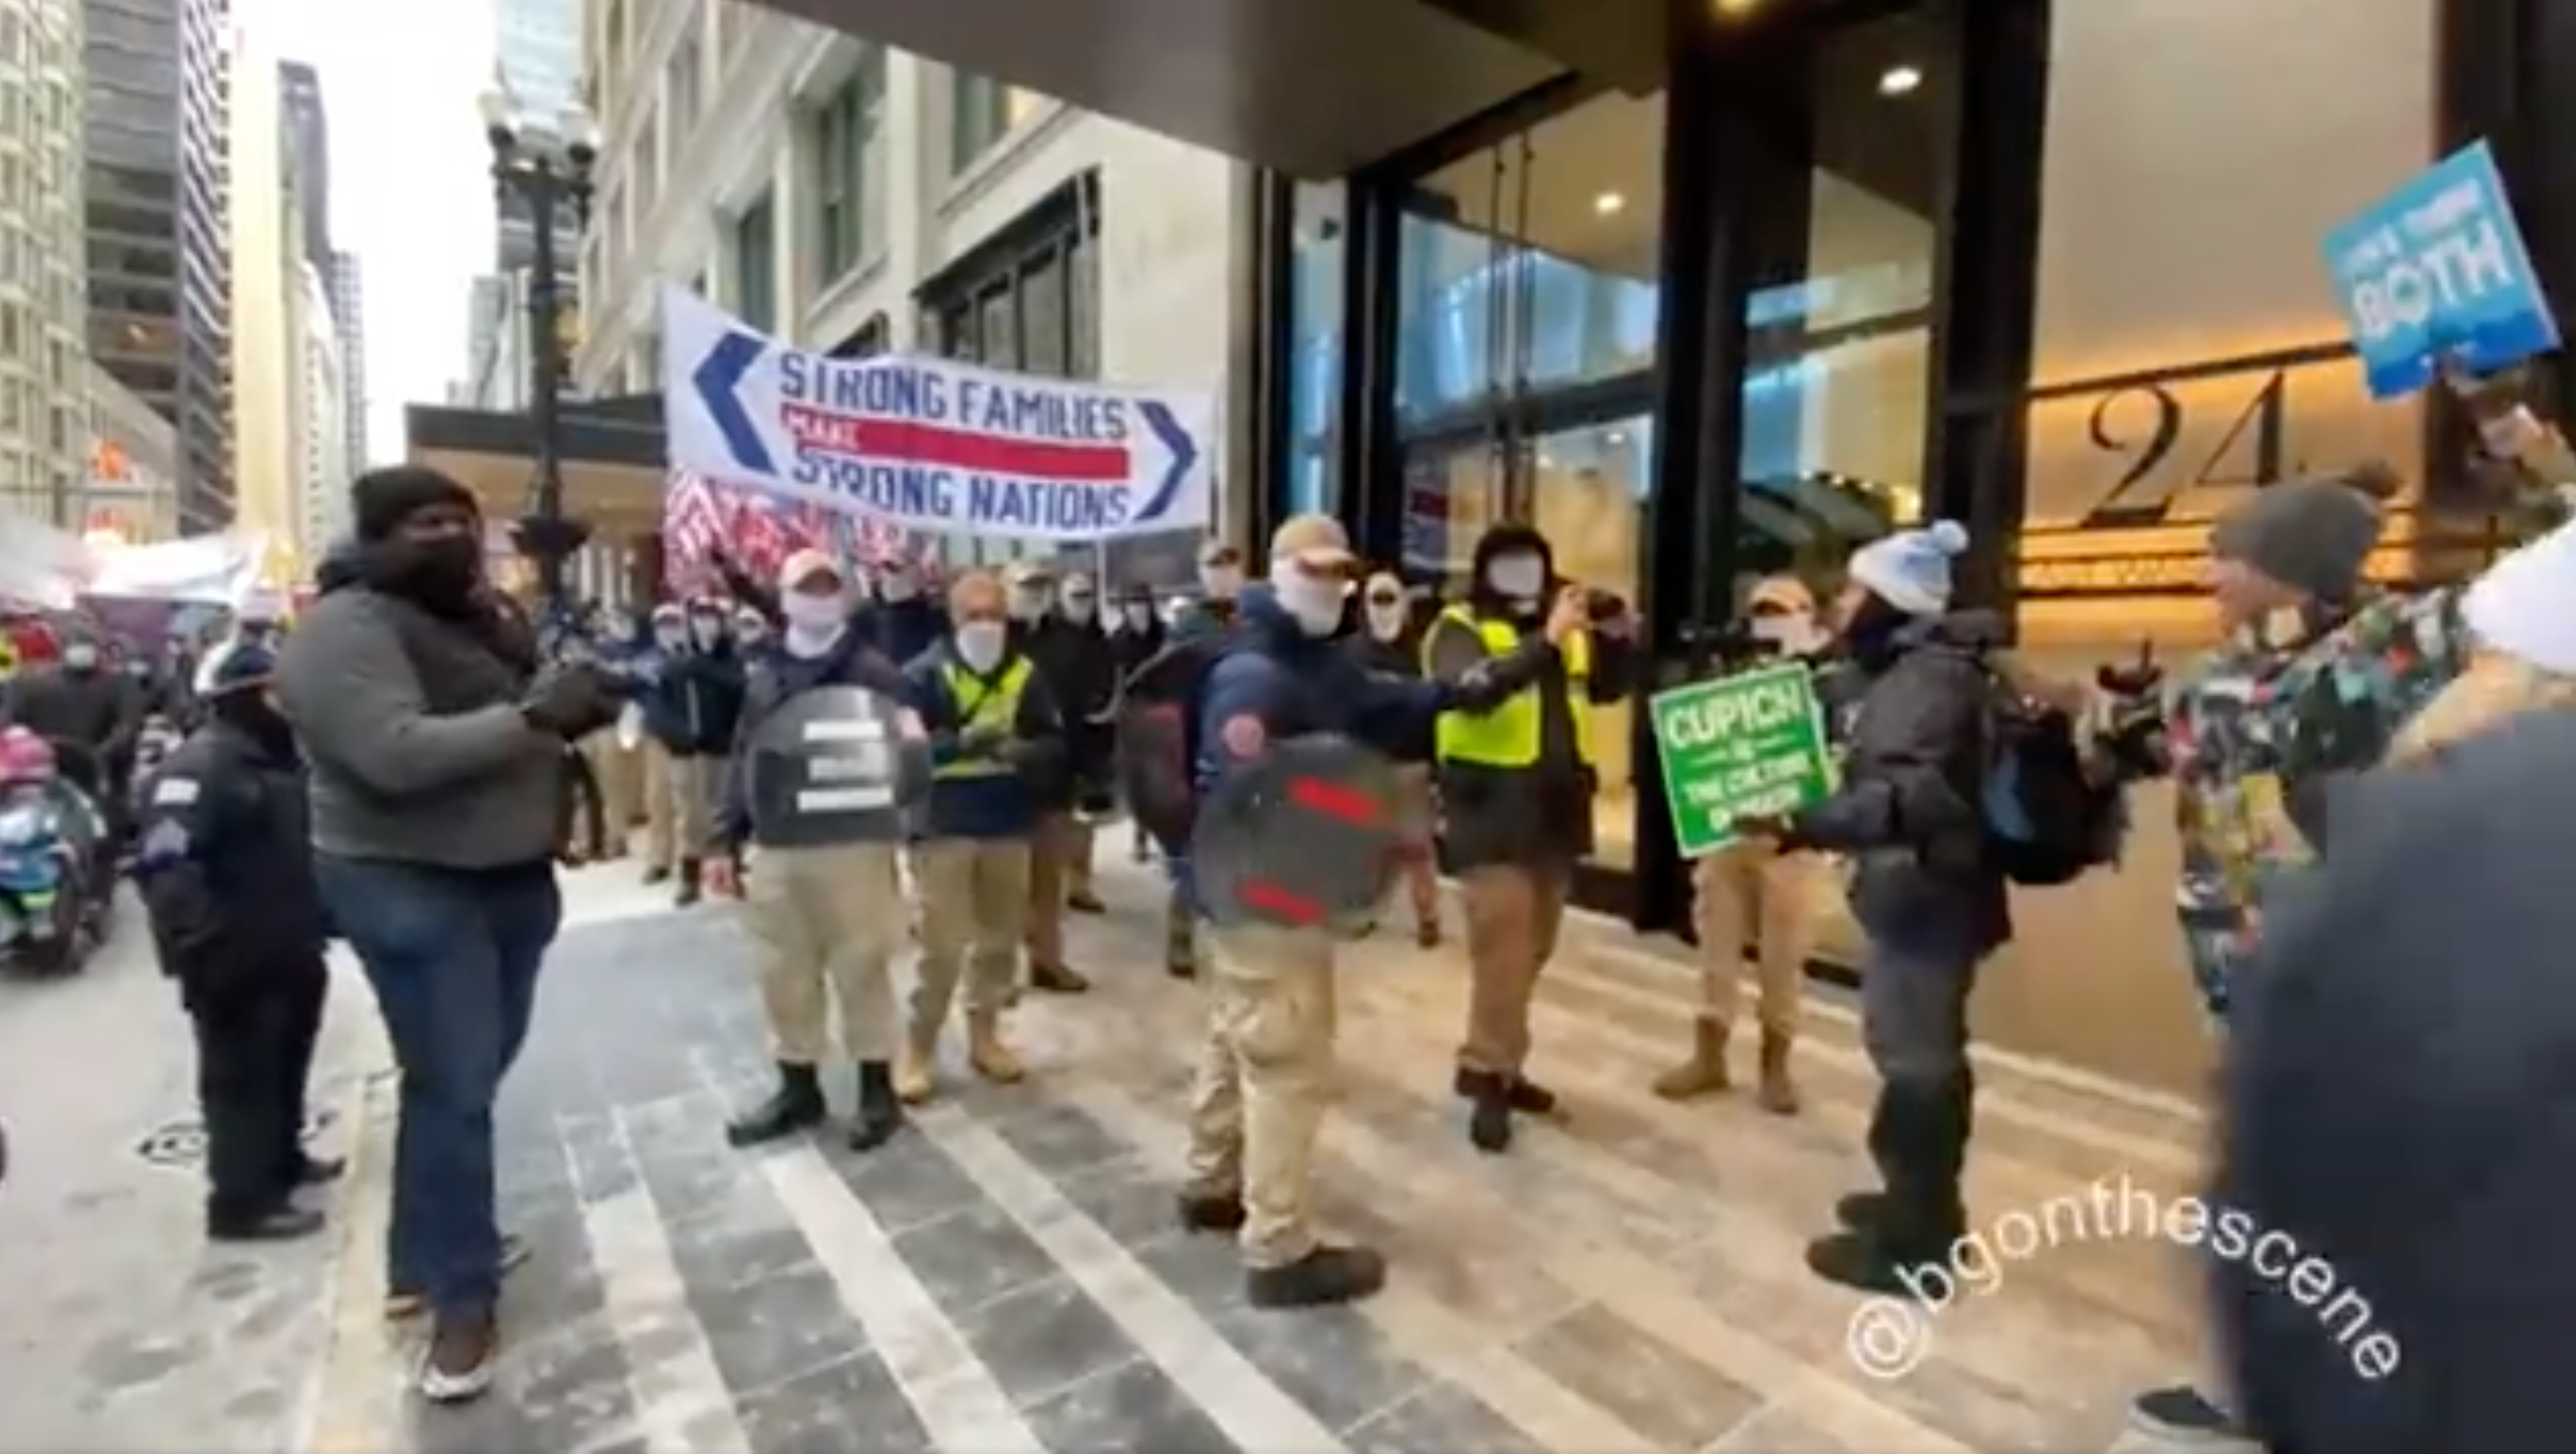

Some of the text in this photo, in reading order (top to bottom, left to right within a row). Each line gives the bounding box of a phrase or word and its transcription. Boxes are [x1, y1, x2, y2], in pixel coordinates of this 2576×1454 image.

[2353, 218, 2515, 338] BOTH
[780, 353, 1126, 441] STRONG FAMILIES
[2081, 368, 2293, 529] 24
[970, 474, 1128, 529] NATIONS
[1667, 682, 1801, 748] CUPICH
